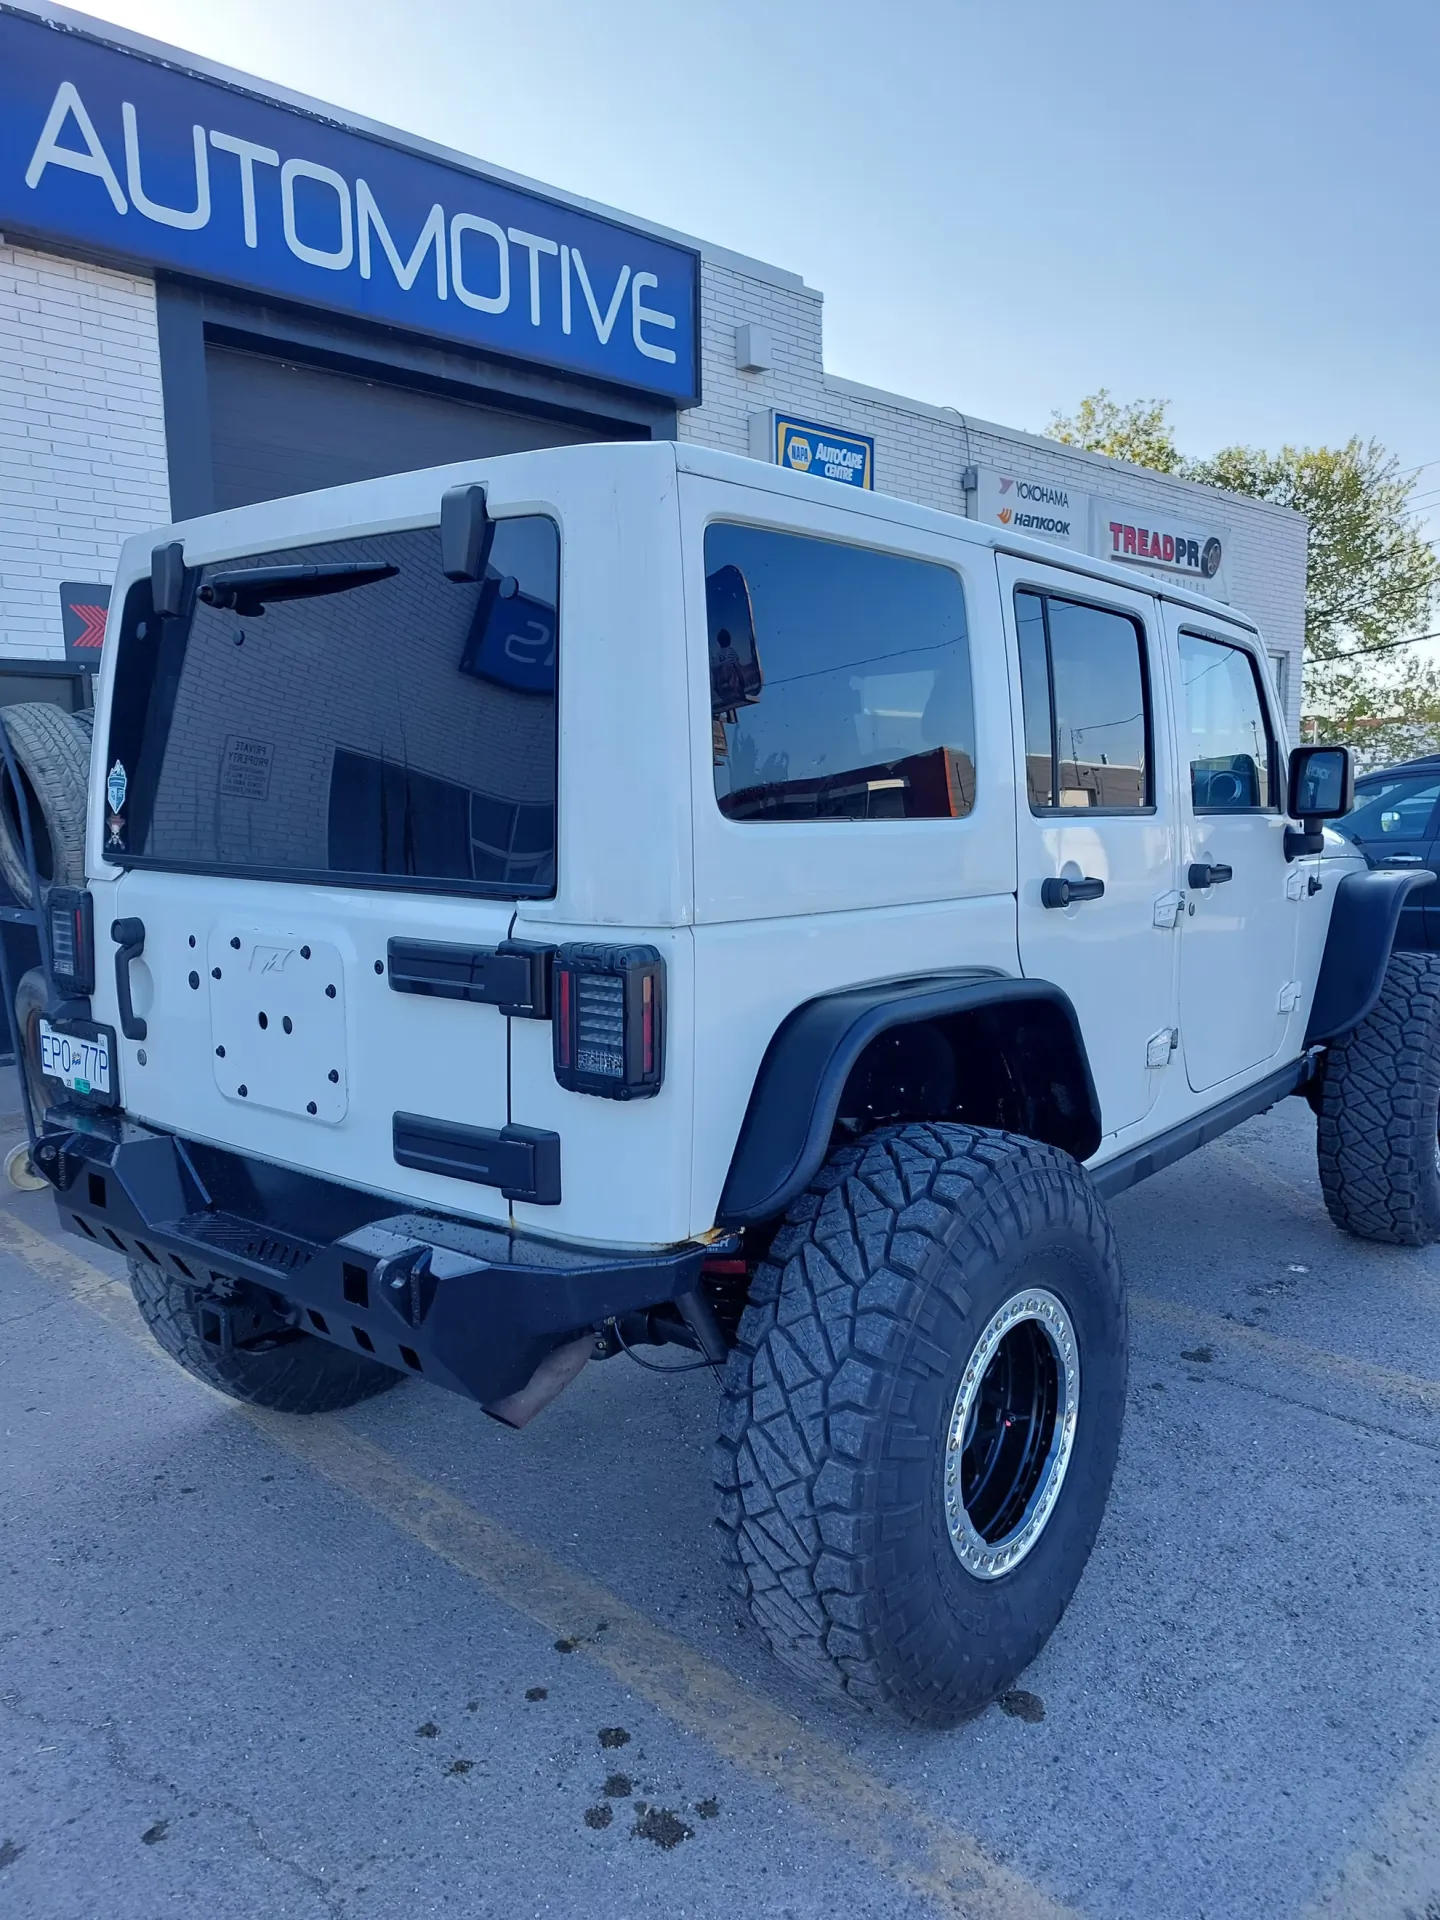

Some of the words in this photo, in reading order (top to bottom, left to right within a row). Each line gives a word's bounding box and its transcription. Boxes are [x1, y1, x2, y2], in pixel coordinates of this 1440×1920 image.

[25, 81, 676, 364] AUTOMOTIVE
[791, 444, 808, 463] NAPA
[824, 463, 854, 481] CENTRE
[1015, 481, 1069, 508] YOKOHAMA
[81, 1044, 108, 1084] 77P
